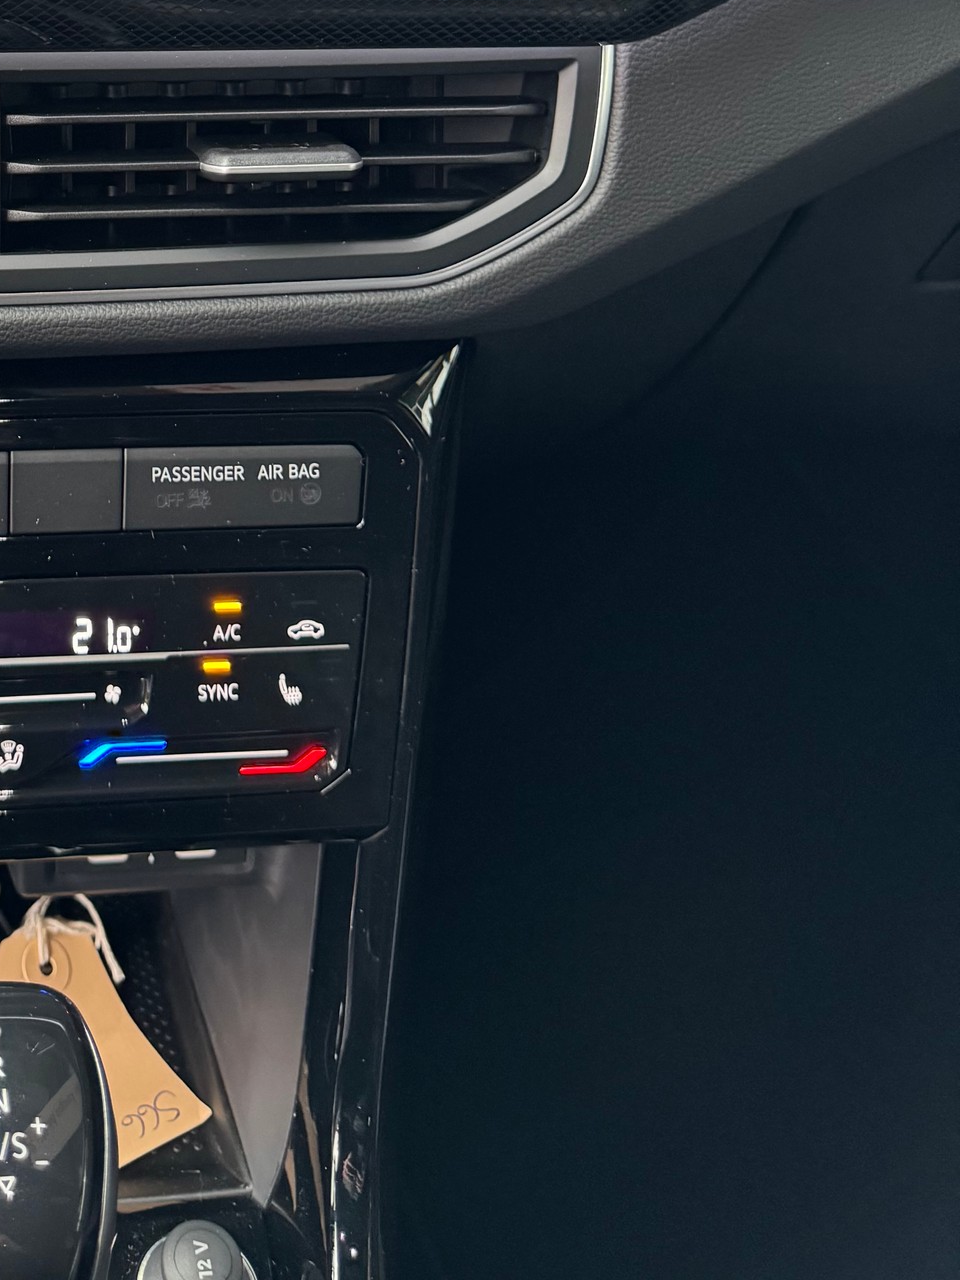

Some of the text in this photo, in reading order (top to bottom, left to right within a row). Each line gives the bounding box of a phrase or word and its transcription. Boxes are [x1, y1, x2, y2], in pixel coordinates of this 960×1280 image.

[151, 462, 321, 484] PASSENGER AIR BAG
[156, 492, 185, 510] OFF
[270, 487, 295, 504] ON
[213, 624, 242, 642] A/C
[197, 683, 240, 703] SYNC
[192, 1239, 215, 1280] 12 V
